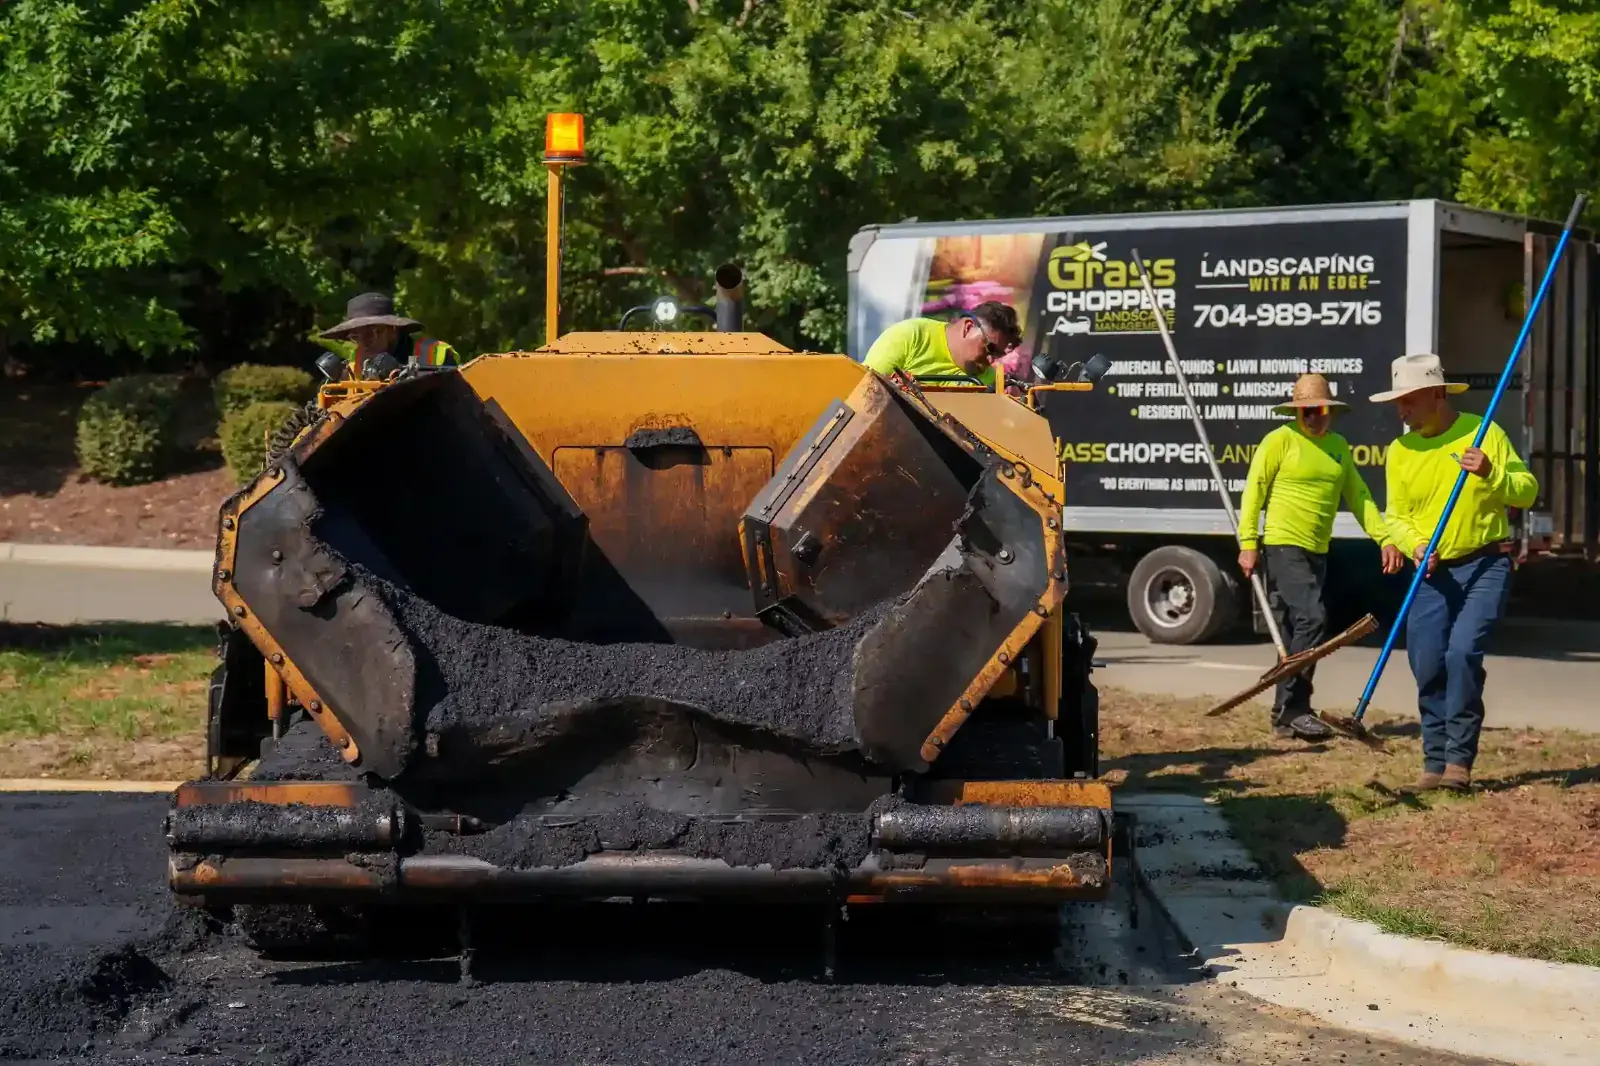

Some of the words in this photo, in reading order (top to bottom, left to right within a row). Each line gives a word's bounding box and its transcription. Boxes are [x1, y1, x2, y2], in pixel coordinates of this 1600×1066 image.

[1048, 245, 1176, 289] Grass
[1201, 255, 1374, 277] LANDSCAPING
[1249, 276, 1290, 292] WITH
[1299, 275, 1319, 291] AN
[1328, 274, 1368, 290] EDGE
[1047, 289, 1176, 312] CHOPPER
[1095, 310, 1176, 322] LANDSCAE
[1193, 301, 1382, 328] 704-989-5716
[1095, 322, 1175, 332] MANAGEMET
[1105, 361, 1163, 375] MMERCIAL
[1227, 359, 1258, 375] LAWN
[1260, 358, 1308, 374] MOWING
[1309, 358, 1363, 374] SERVICES
[1117, 382, 1144, 397] TURF
[1145, 382, 1218, 397] FERTILIATION
[1233, 382, 1293, 397] LANDSCAPE
[1138, 405, 1203, 419] RESIDENTIL
[1205, 404, 1236, 419] LAWN
[1118, 477, 1170, 491] EVERYTHING
[1171, 478, 1184, 491] AS
[1185, 478, 1209, 492] UNTO
